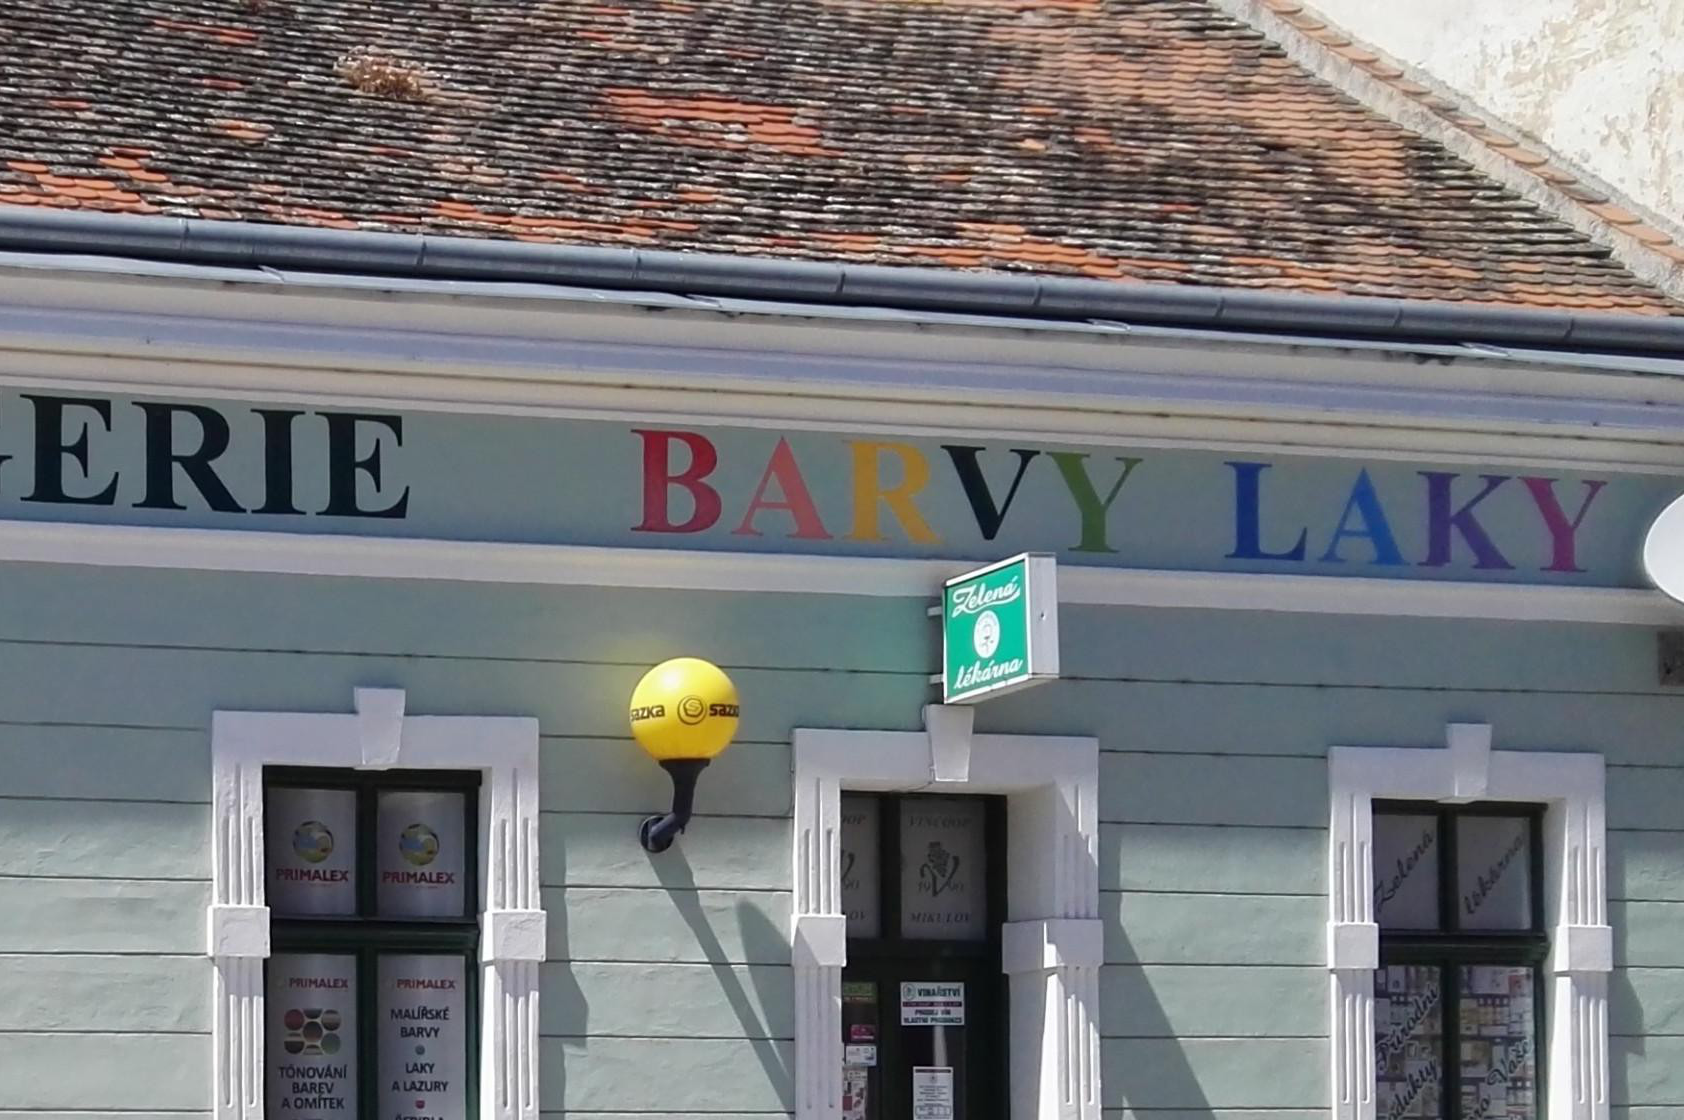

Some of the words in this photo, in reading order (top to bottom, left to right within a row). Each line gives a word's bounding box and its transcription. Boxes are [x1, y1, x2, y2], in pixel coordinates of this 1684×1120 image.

[631, 428, 1144, 554] BARVY
[1223, 461, 1608, 573] LAKY
[952, 576, 1021, 617] Zelená
[953, 658, 1023, 690] lékárna
[275, 868, 349, 883] PRIMALEX
[382, 871, 455, 885] PRIMALEX
[289, 977, 349, 989] PRIMALEX
[396, 978, 456, 990] PRIMALEX
[390, 1007, 450, 1021] MALÍŘSKÉ
[400, 1027, 440, 1038] BARVY
[278, 1064, 348, 1079] TÓNOVÁNÍ
[405, 1063, 435, 1074] LAKY
[292, 1082, 334, 1095] BAREV
[391, 1081, 401, 1092] A
[403, 1081, 449, 1092] LAZURY
[282, 1098, 291, 1109] A
[294, 1095, 345, 1110] OMÍTEK
